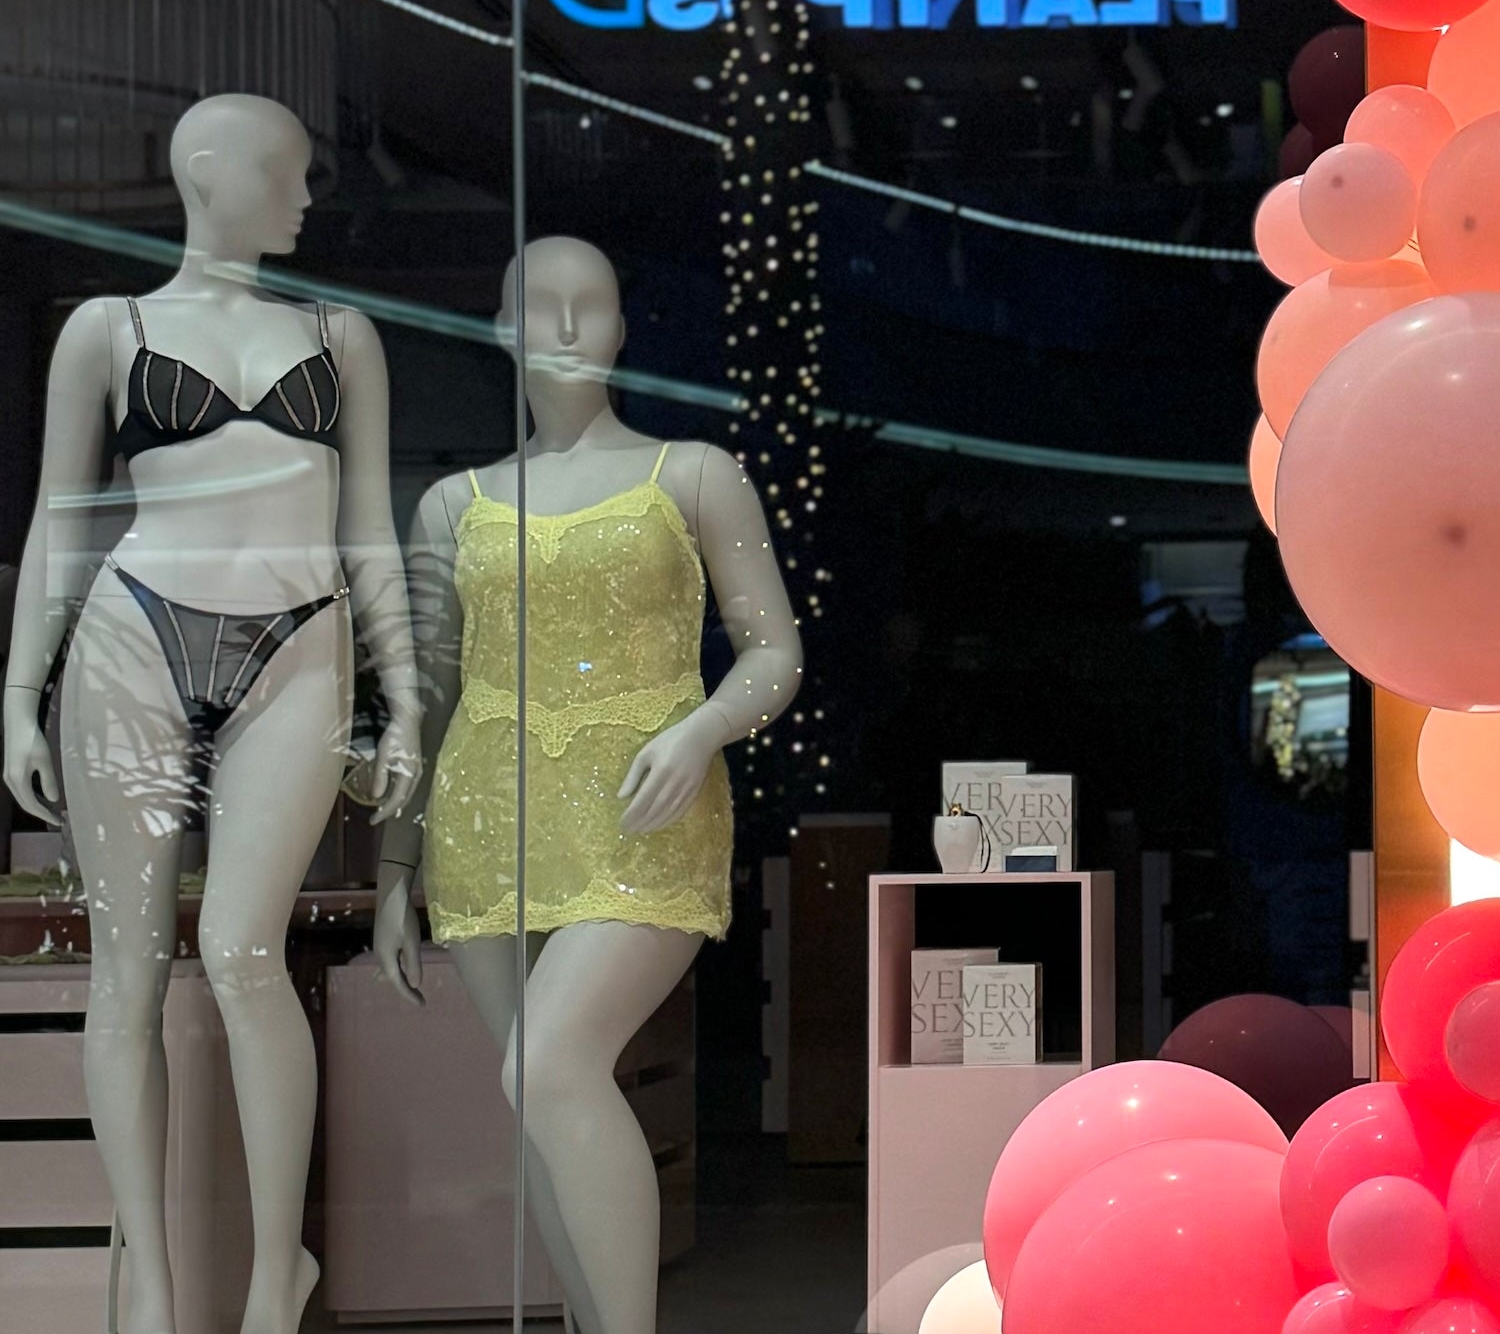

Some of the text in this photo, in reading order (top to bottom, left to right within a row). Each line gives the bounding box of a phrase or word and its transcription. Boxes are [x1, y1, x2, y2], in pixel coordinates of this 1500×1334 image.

[1001, 793, 1071, 818] VERY
[1001, 820, 1071, 845] SEXY
[963, 983, 1034, 1008] VERY
[911, 1003, 963, 1033] SEX
[963, 1010, 1034, 1037] SEXY
